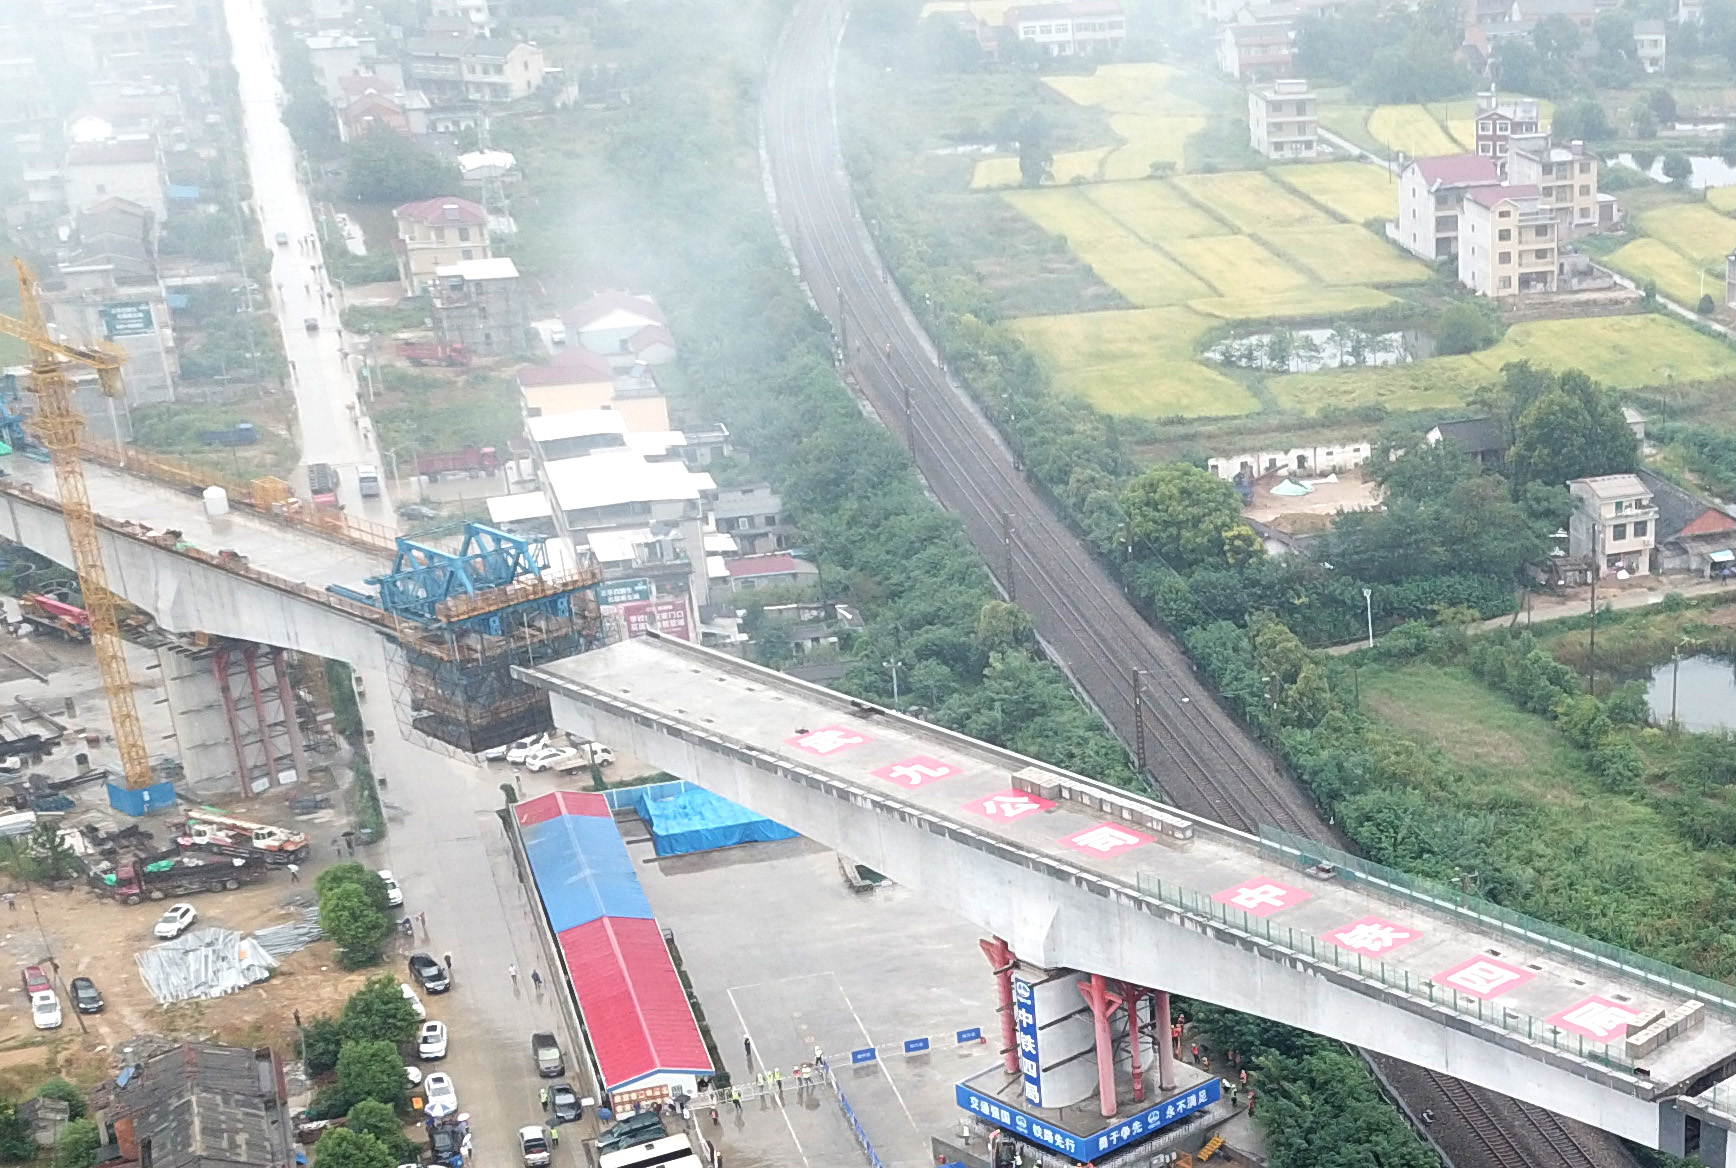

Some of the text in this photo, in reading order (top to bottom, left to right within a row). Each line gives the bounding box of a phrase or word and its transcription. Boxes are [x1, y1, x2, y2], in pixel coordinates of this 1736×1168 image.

[796, 729, 1642, 1037] 武九公司 中铁四局
[1018, 1008, 1040, 1104] 中铁四局
[969, 1096, 1076, 1153] 交通强国 铁路先行
[1098, 1089, 1208, 1151] 勇于争先 永不满足
